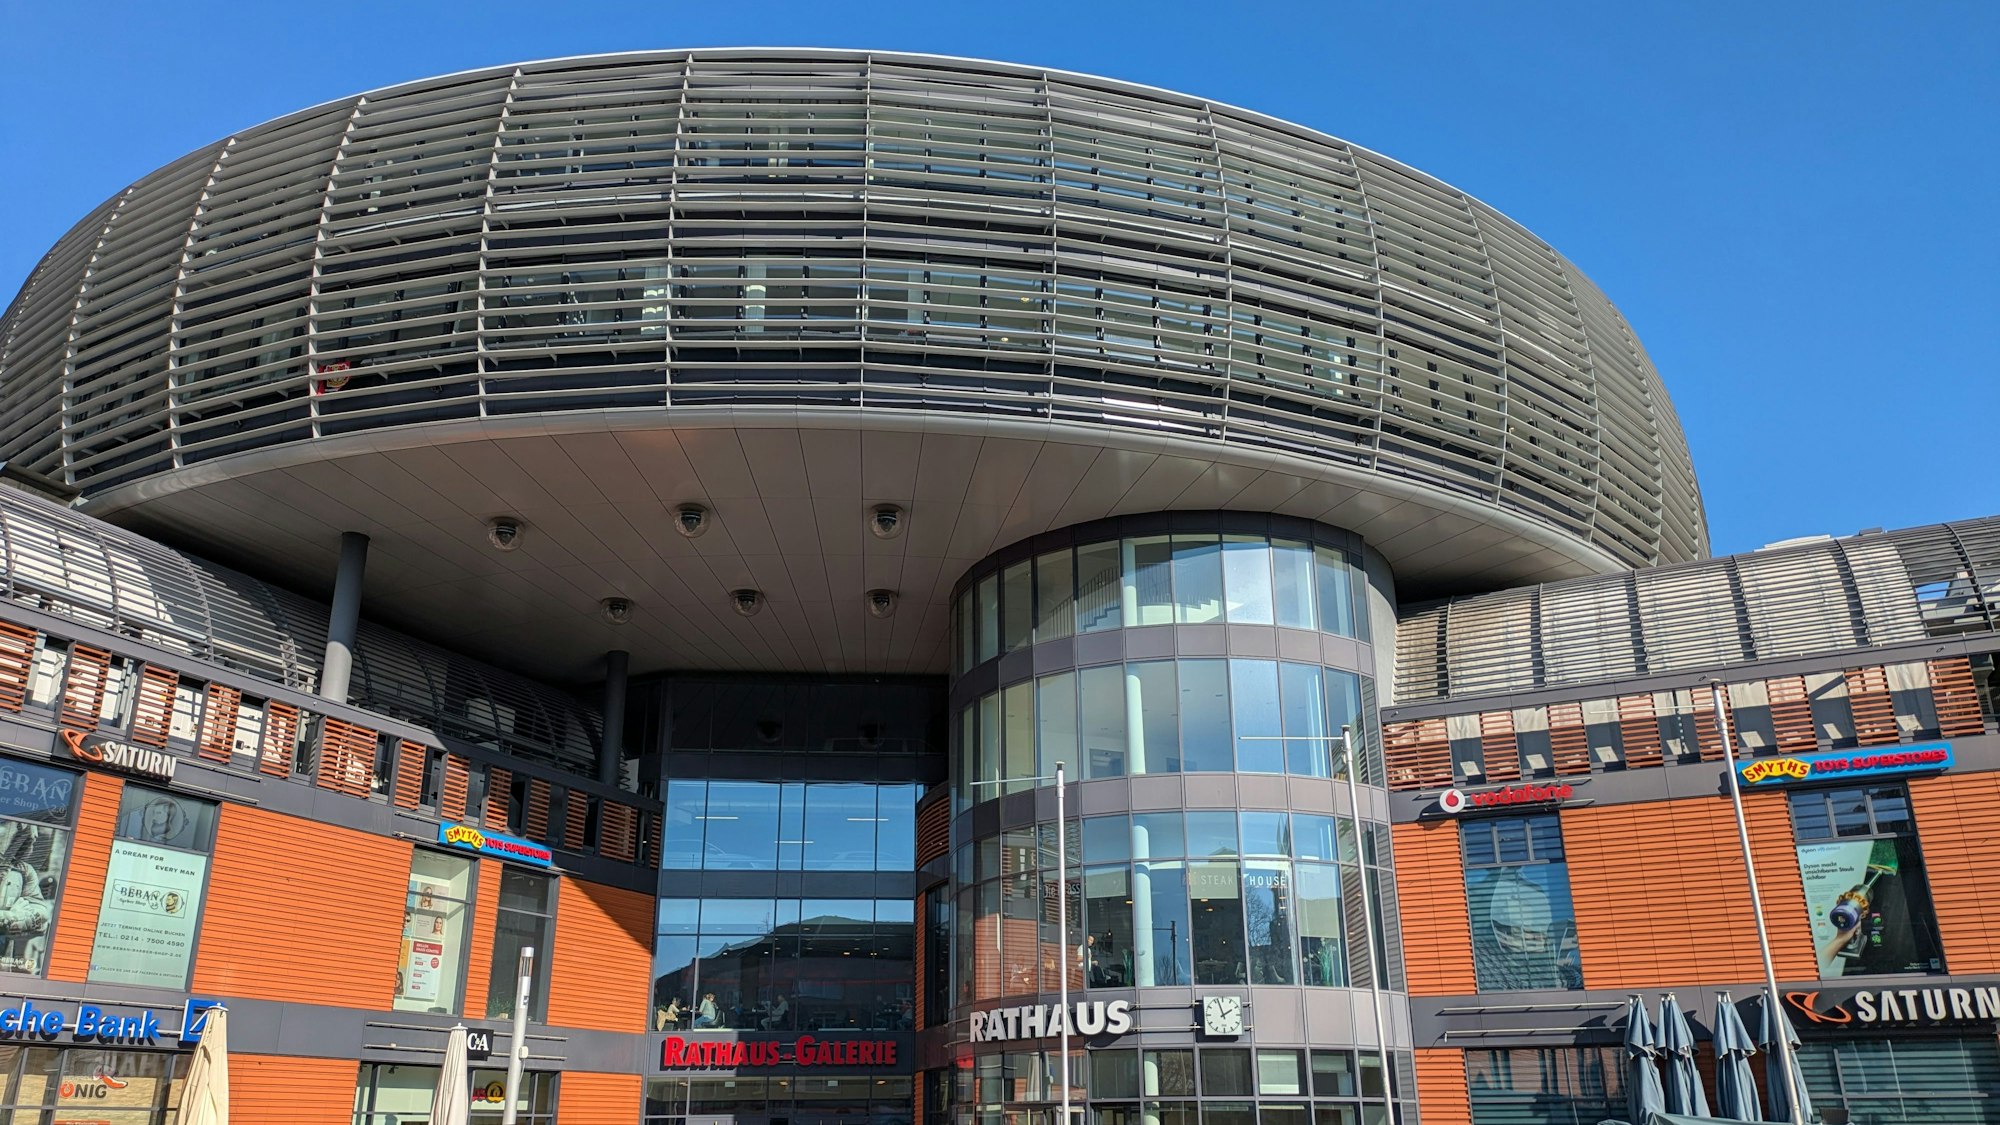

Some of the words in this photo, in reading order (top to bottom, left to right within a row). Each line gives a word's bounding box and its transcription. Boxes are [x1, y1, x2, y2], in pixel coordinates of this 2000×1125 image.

[104, 741, 177, 777] SATURN
[1745, 760, 1809, 781] SMYTHS
[1814, 757, 1849, 771] TOYS
[1852, 749, 1948, 768] SUPERSTORES
[14, 797, 39, 811] Shop
[1471, 784, 1573, 806] vodafone
[447, 828, 484, 847] SMYTHS
[486, 837, 504, 850] TOYS
[122, 850, 148, 859] DREAM
[155, 865, 178, 873] EVERY
[1200, 875, 1234, 886] STEAK
[1250, 875, 1286, 886] HOUSE
[118, 885, 160, 902] BEBAN
[98, 931, 118, 940] TEL.:
[118, 923, 141, 932] TERMINE
[1855, 986, 2000, 1023] SATURN
[0, 1002, 64, 1034] che
[74, 1005, 160, 1040] Bank
[970, 1000, 1132, 1042] RATHAUS
[467, 1033, 489, 1051] C&A
